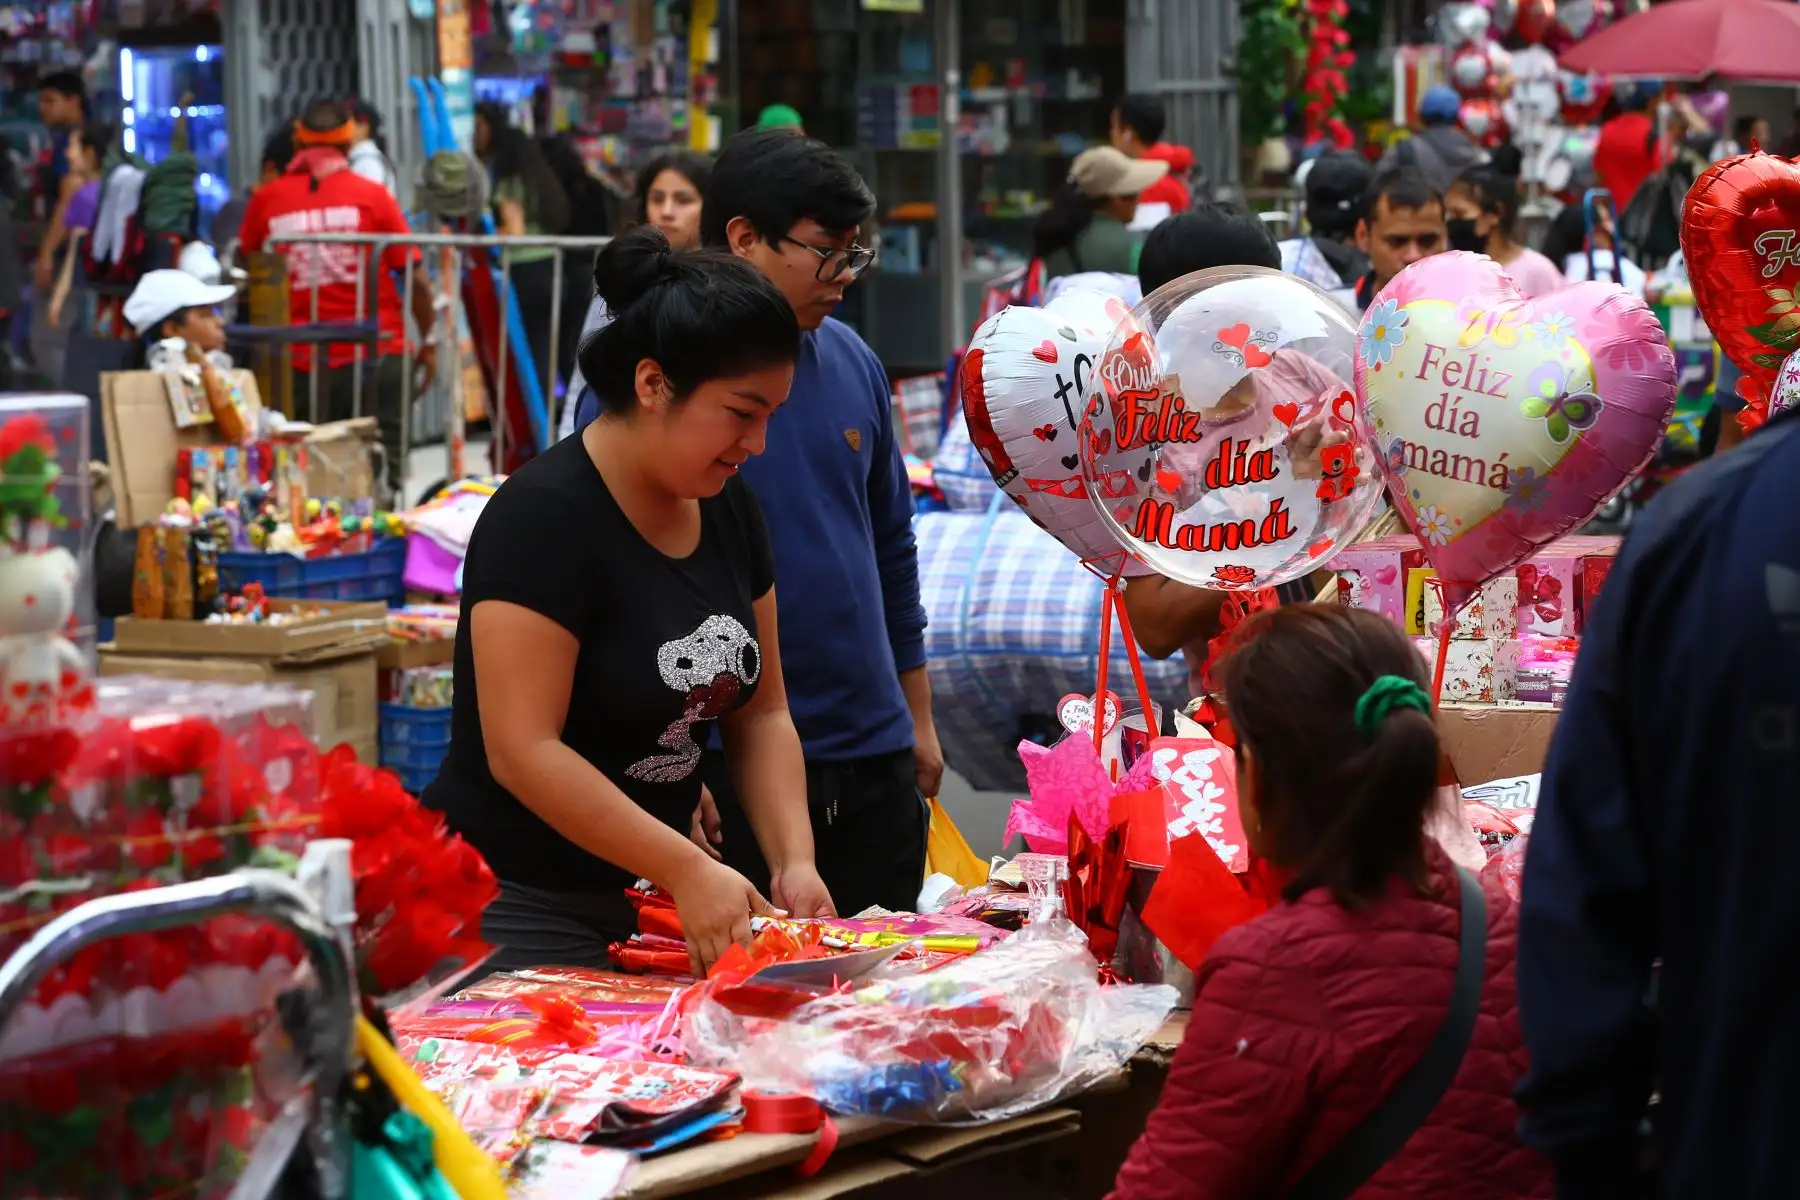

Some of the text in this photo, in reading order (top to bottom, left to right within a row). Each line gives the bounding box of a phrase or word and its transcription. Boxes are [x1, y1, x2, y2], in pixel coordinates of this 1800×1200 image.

[1414, 343, 1514, 400] Feliz
[1115, 387, 1203, 450] Feliz
[1424, 393, 1481, 439] día
[1204, 436, 1280, 490] día
[1399, 439, 1512, 490] mamá
[1124, 496, 1298, 553] Mamá
